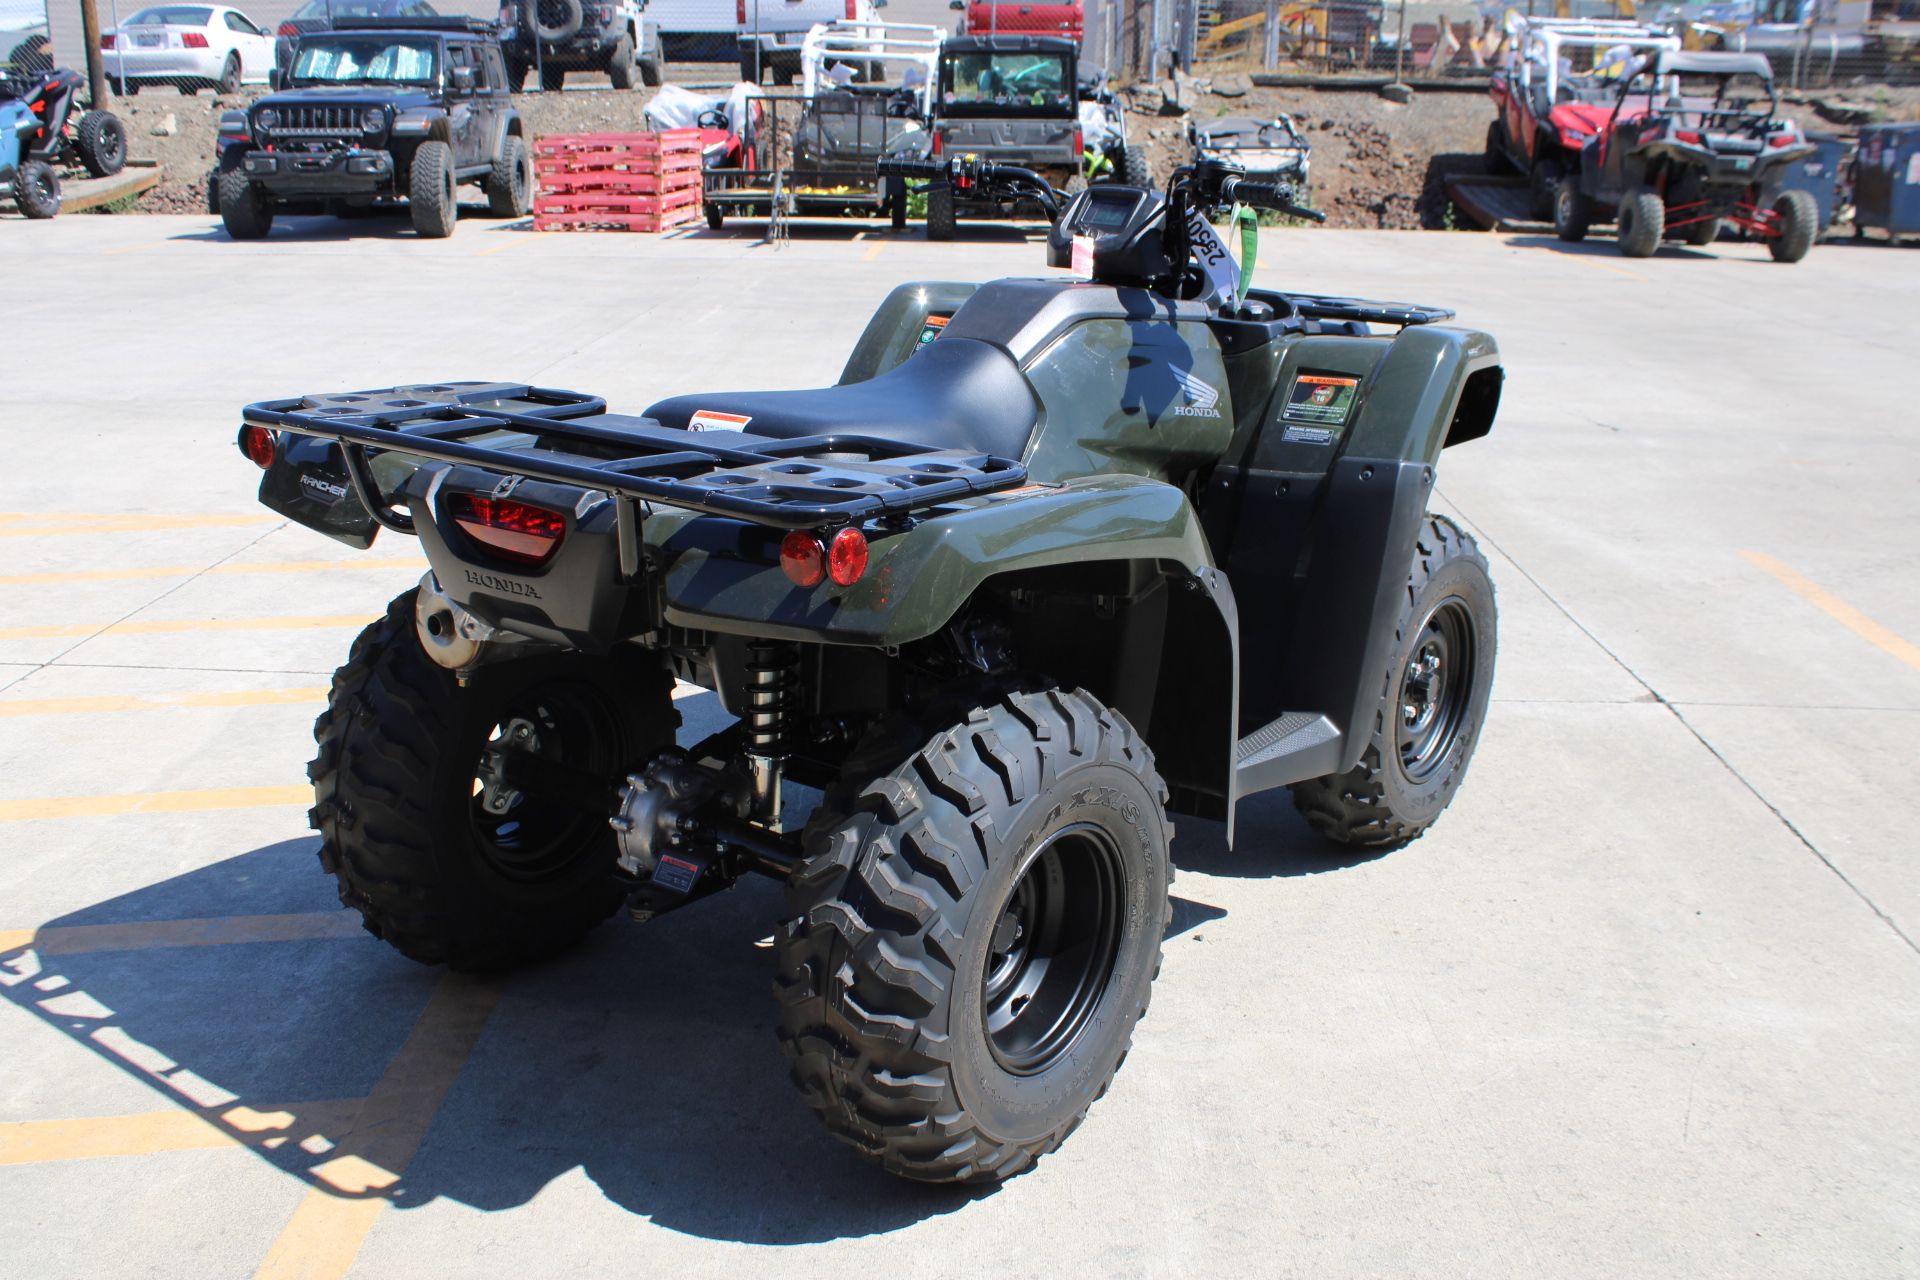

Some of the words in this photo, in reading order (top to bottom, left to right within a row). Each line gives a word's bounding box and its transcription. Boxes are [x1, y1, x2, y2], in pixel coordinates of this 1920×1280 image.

[1174, 406, 1221, 418] HONDA
[300, 474, 346, 498] RANCHER
[465, 570, 542, 599] HONDA
